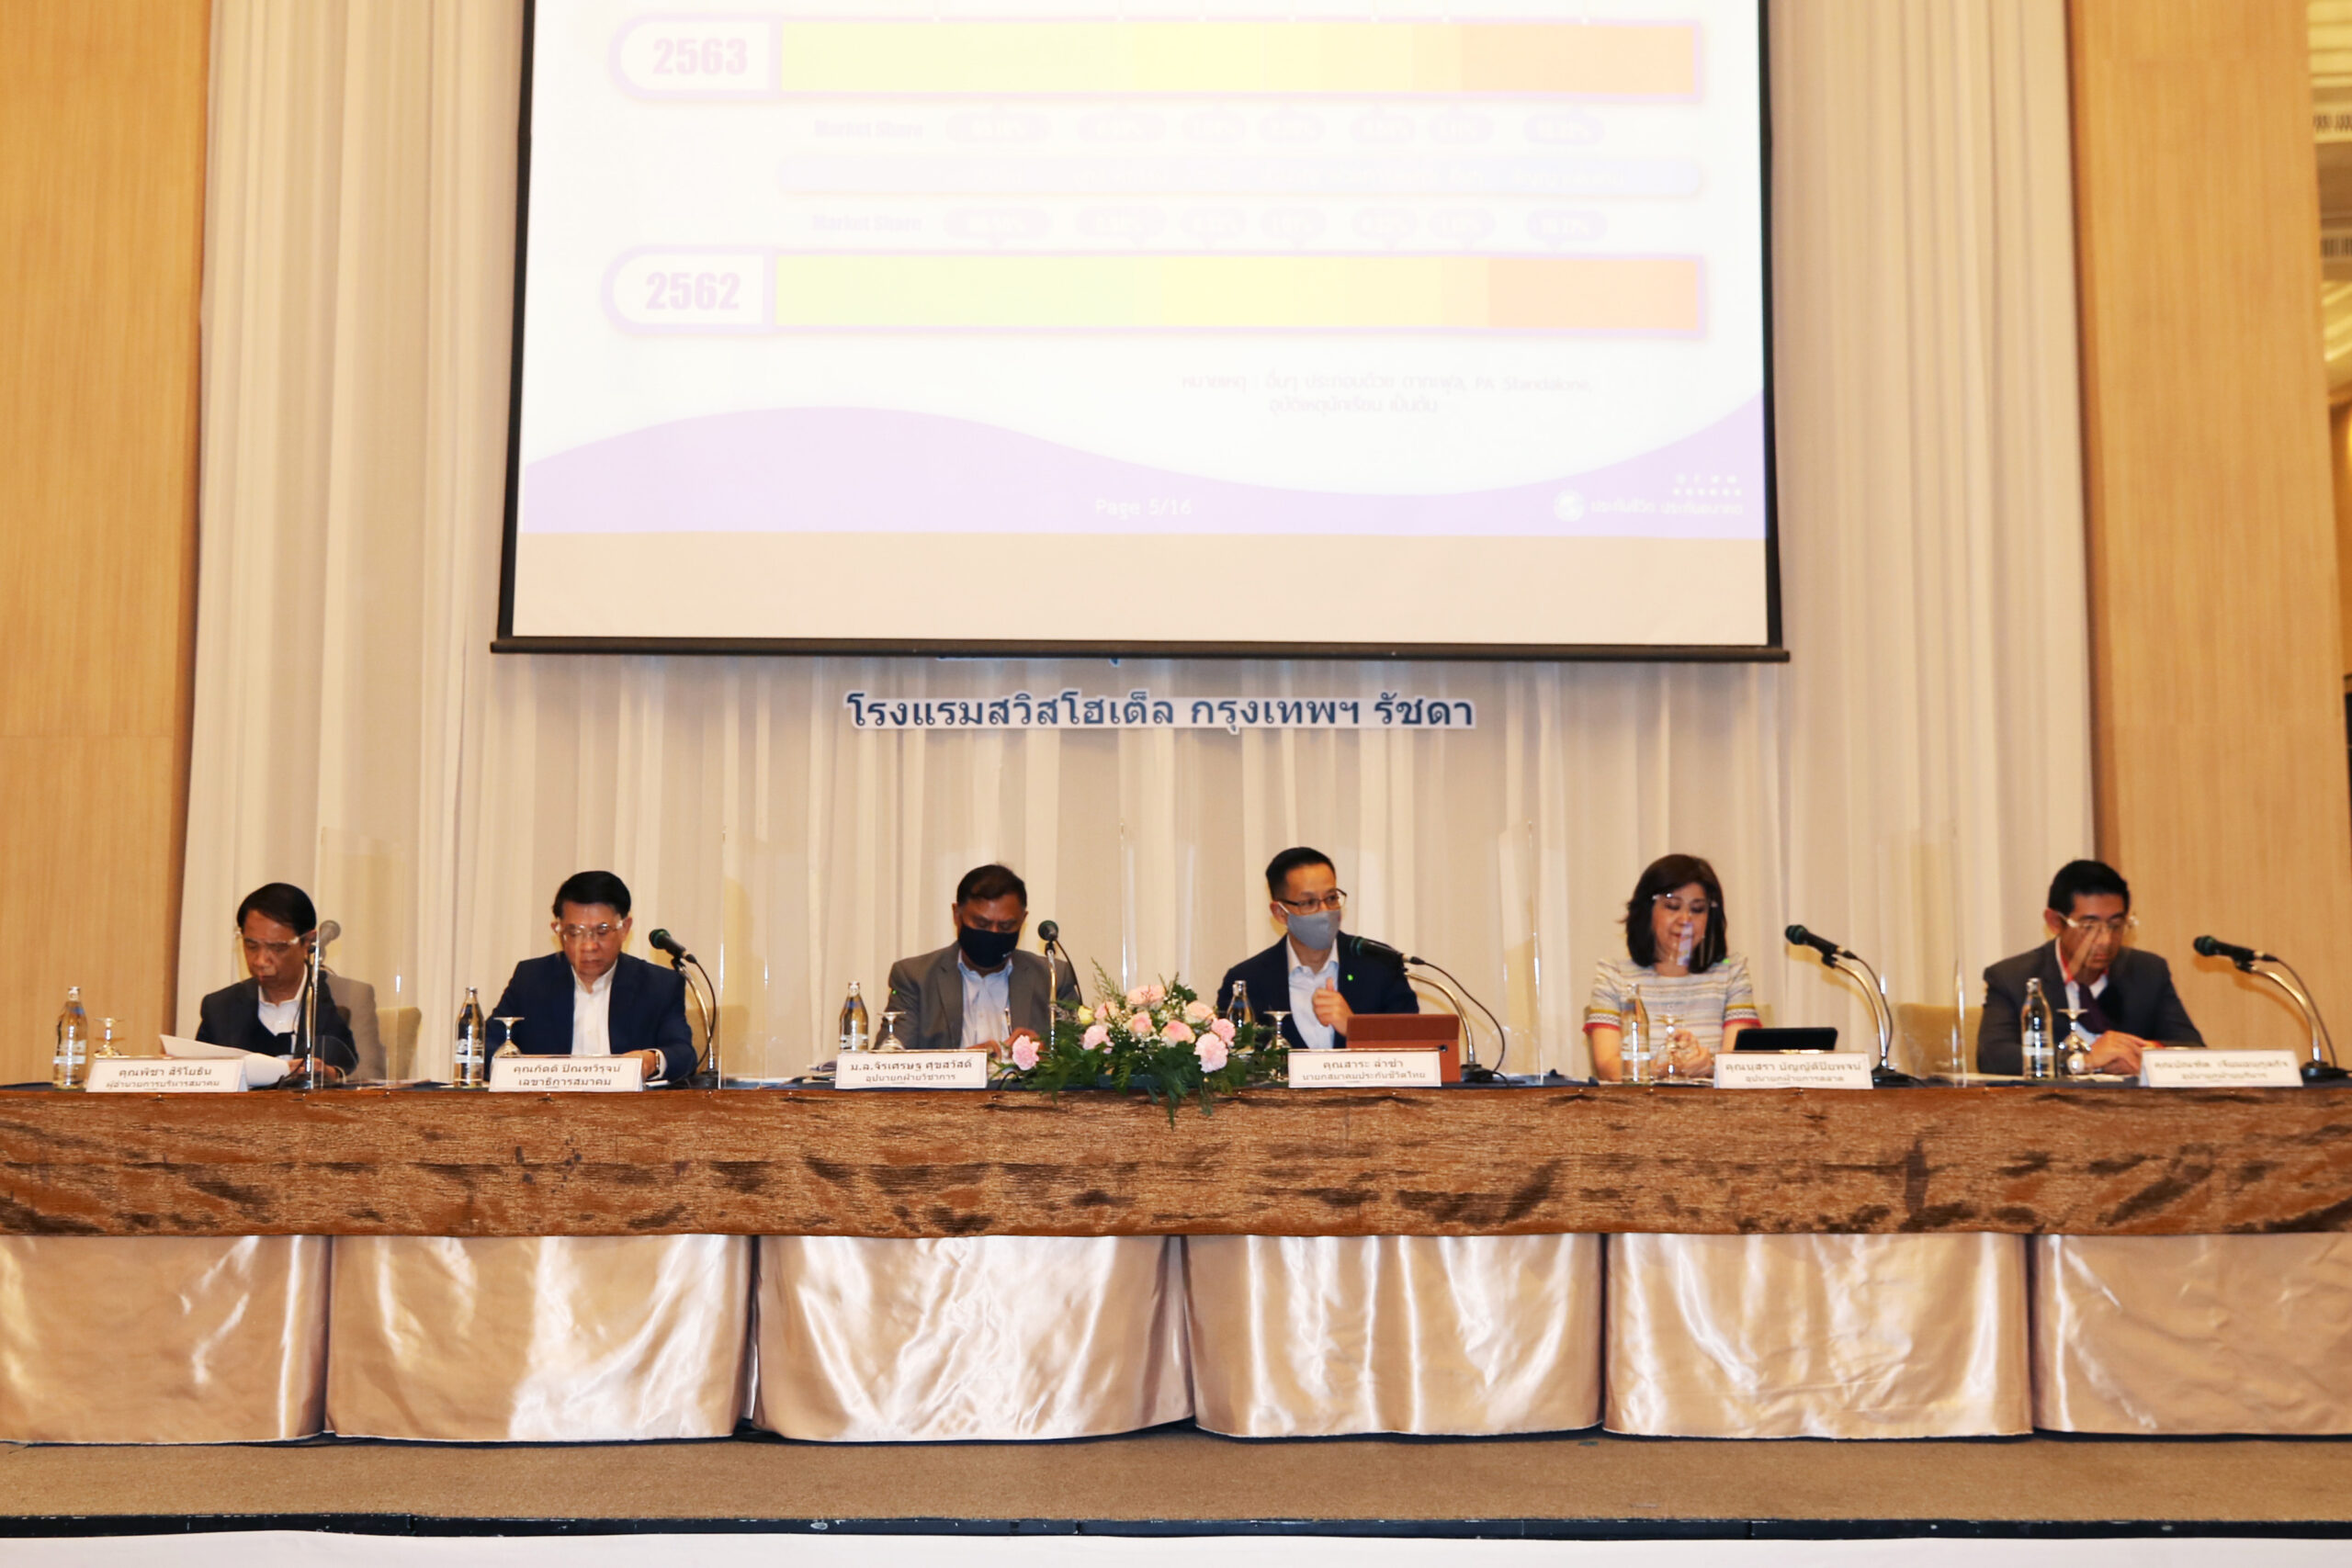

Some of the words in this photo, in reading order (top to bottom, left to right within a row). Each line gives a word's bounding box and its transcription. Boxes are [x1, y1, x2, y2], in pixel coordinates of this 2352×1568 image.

[652, 37, 749, 76] 2563
[645, 272, 741, 310] 2562
[1095, 499, 1141, 521] Page
[1148, 499, 1192, 515] 5/16
[846, 692, 1174, 728] โรงแรมสวิสโฮเต็ล
[1192, 699, 1361, 733] กรุงเทพฯ
[1374, 694, 1474, 727] รัชดา
